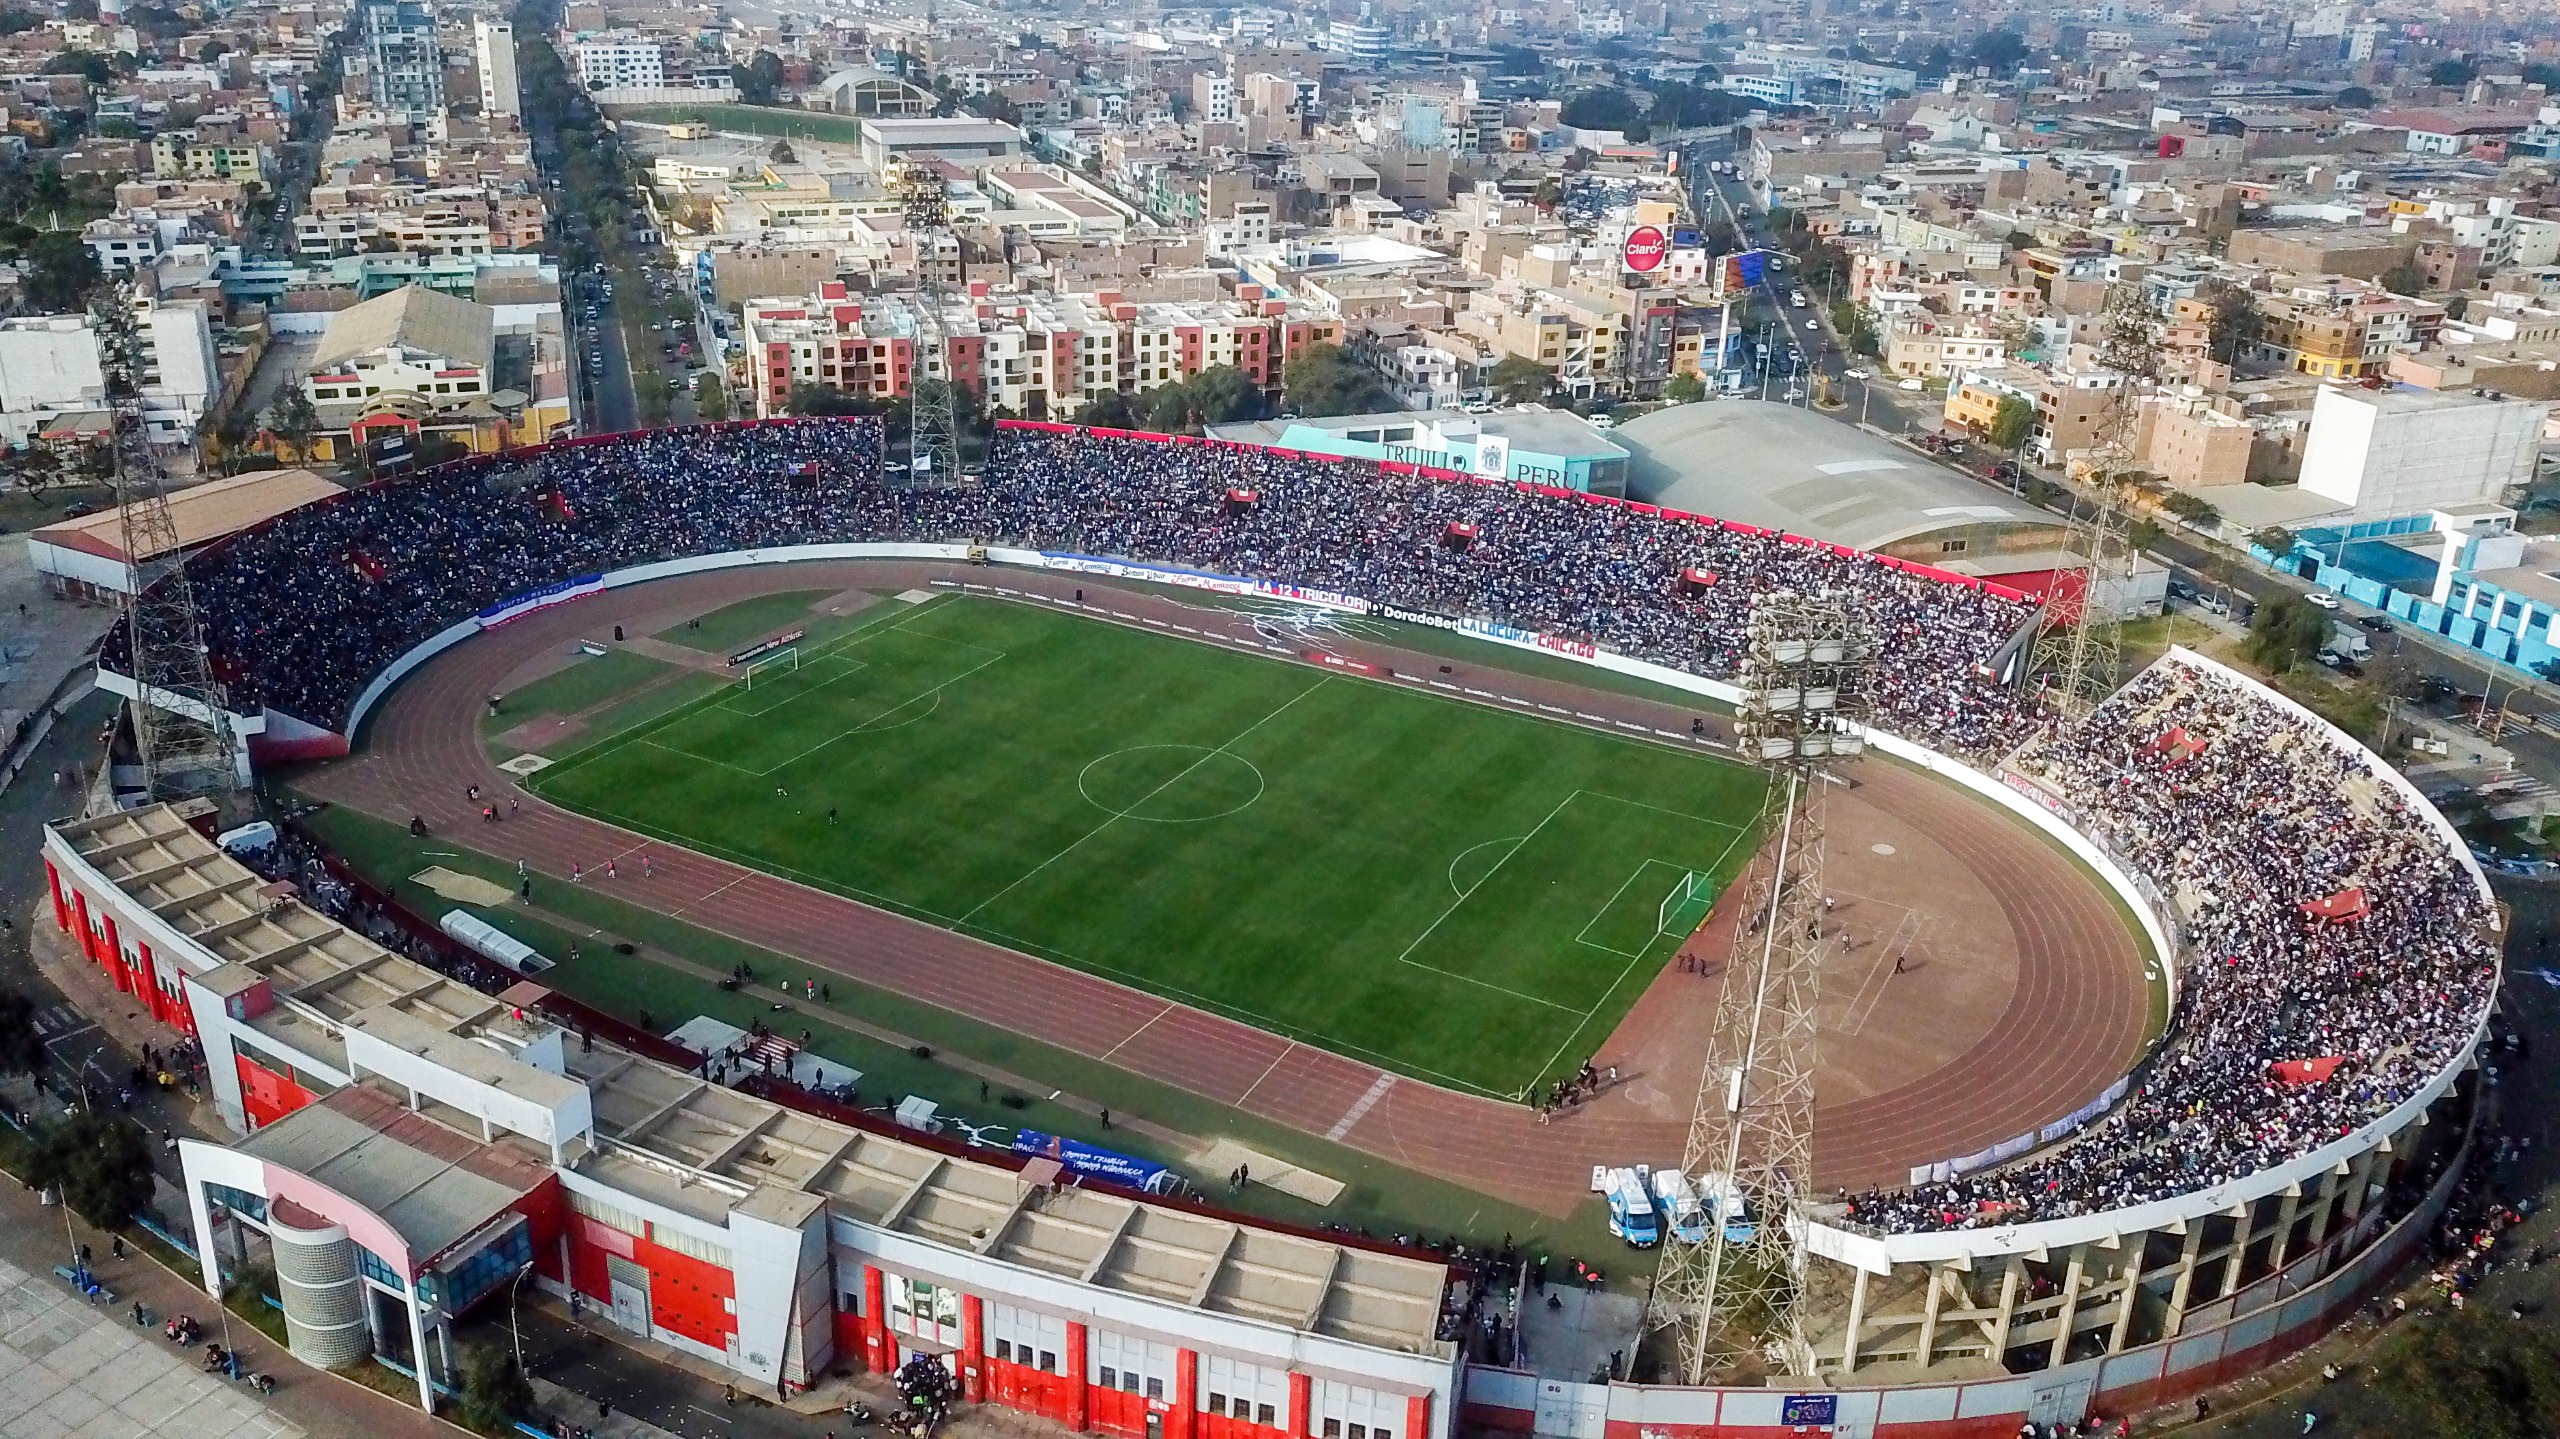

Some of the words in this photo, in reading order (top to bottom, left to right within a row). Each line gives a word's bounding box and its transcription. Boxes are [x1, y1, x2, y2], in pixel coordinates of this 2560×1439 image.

[1627, 242, 1660, 254] Claro
[1383, 444, 1466, 471] TRUJILLO
[1518, 464, 1579, 490] PERU
[1255, 580, 1273, 593] LA
[1278, 583, 1292, 596] 12
[1297, 586, 1364, 610] TRICOLOR
[1384, 605, 1458, 631] DoradoBet
[1537, 633, 1596, 659] CHICAGO
